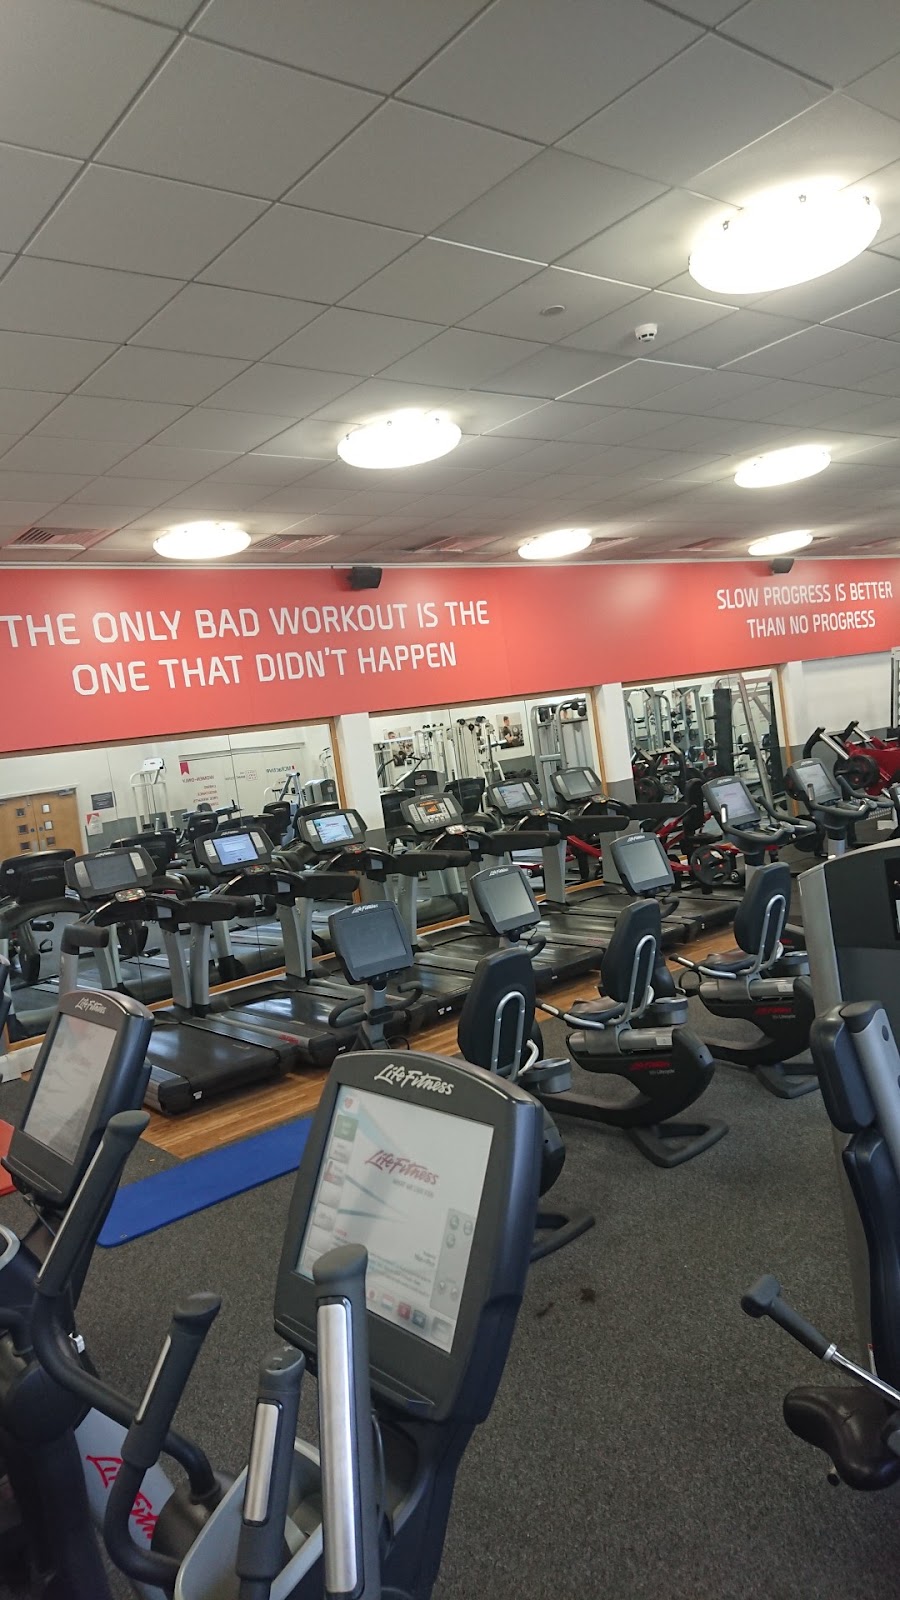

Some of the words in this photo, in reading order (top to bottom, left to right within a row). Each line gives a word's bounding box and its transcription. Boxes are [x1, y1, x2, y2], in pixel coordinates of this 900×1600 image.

[716, 587, 759, 610] SLOW
[763, 584, 831, 606] PROGRESS
[835, 583, 847, 602] IS
[849, 581, 893, 601] BETTER
[0, 613, 80, 648] THE
[92, 610, 181, 643] ONLY
[195, 608, 260, 639] BAD
[269, 603, 408, 635] WORKOUT
[416, 602, 438, 628] IS
[444, 600, 490, 627] THE
[747, 617, 786, 639] THAN
[790, 614, 809, 635] NO
[813, 610, 876, 633] PROGRESS
[72, 661, 150, 696] ONE
[158, 655, 243, 689] THAT
[255, 647, 347, 682] DIDN'T
[357, 641, 457, 674] HAPPEN
